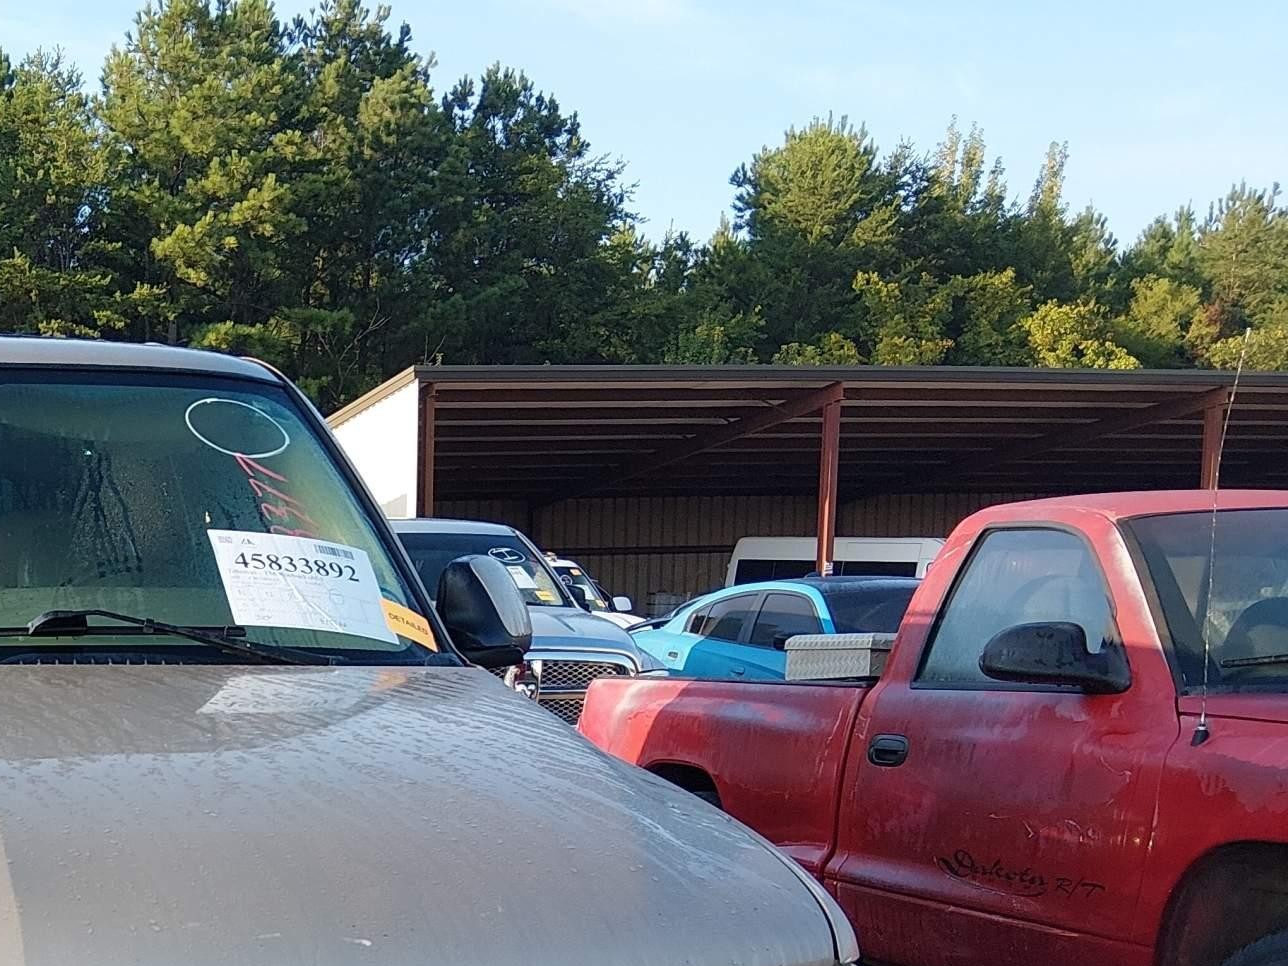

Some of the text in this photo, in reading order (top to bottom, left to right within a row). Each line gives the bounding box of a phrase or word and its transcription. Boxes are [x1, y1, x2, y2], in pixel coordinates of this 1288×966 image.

[234, 551, 360, 583] 45833892
[387, 612, 429, 636] DETAILED
[1055, 876, 1106, 899] R/T
